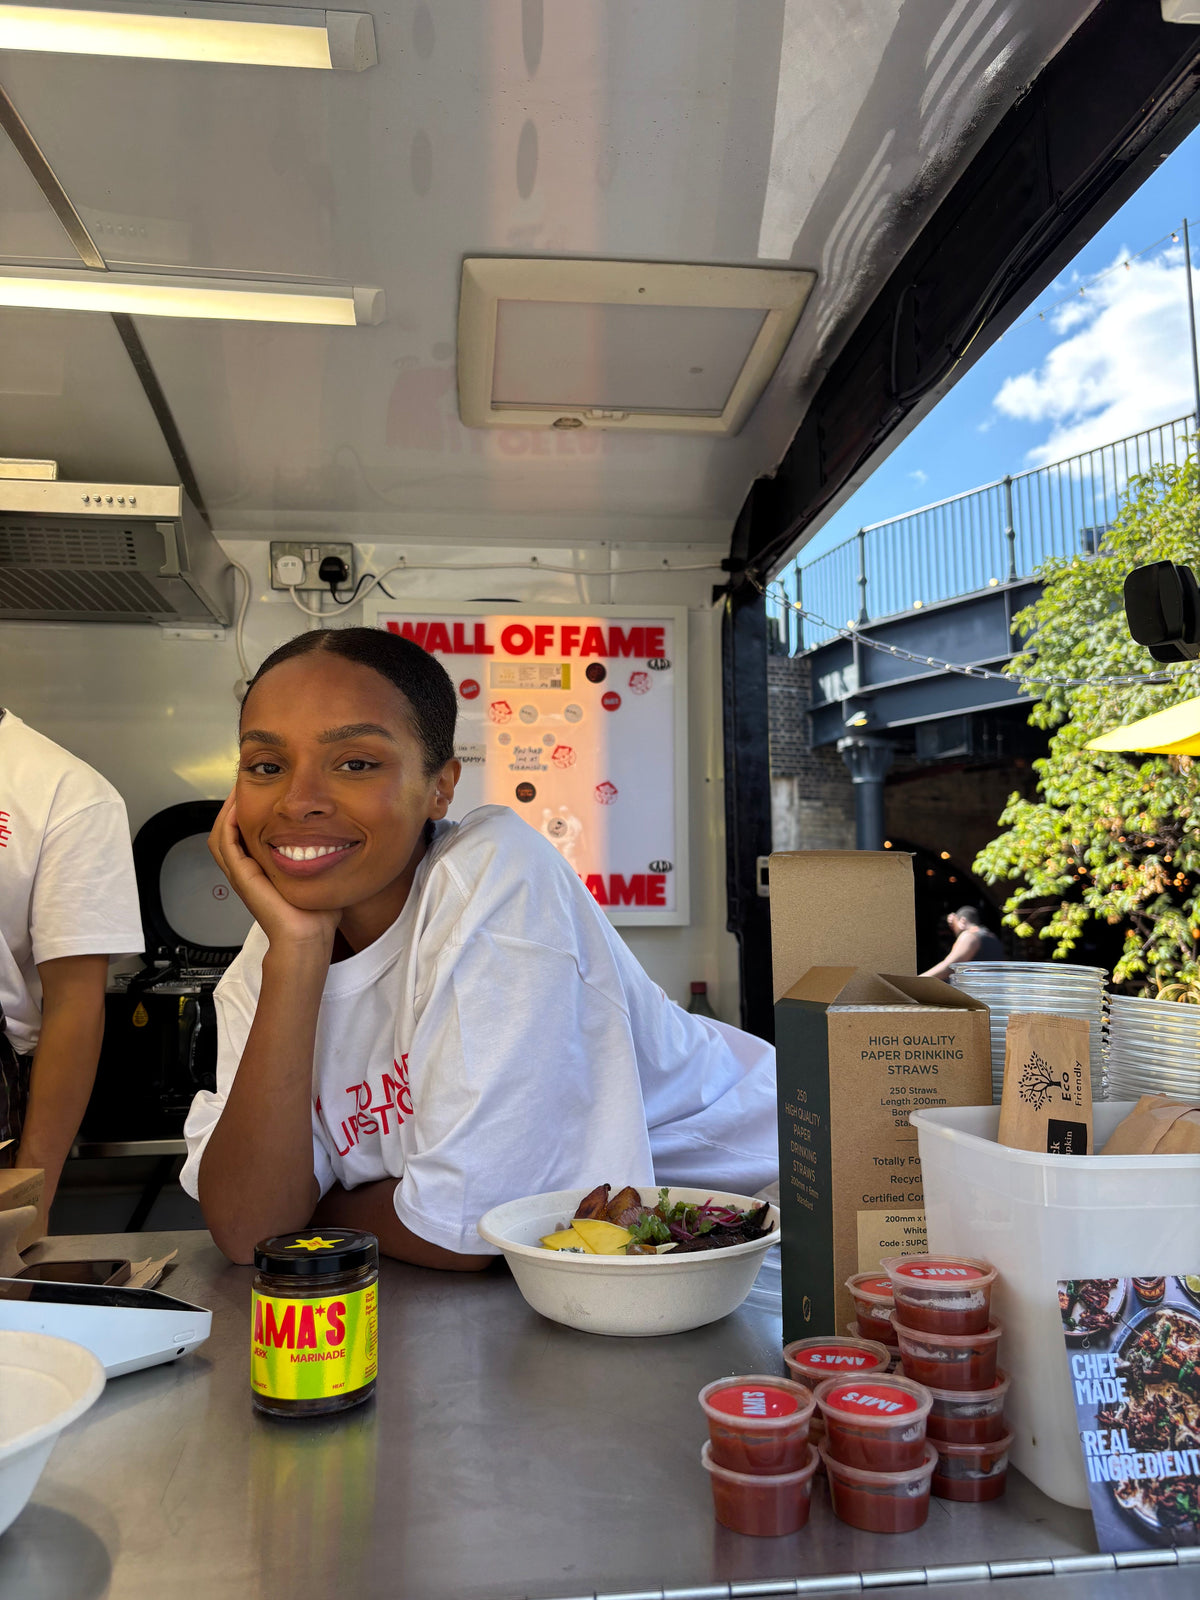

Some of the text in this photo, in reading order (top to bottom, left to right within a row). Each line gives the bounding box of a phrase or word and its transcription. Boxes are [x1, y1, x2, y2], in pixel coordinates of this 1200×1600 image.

[387, 621, 665, 658] WALL OF FAME
[581, 874, 666, 906] AME
[869, 1035, 956, 1046] HIGH QUALITY
[861, 1050, 963, 1060] PAPER DRINKING
[888, 1064, 939, 1075] STRAWS
[890, 1086, 938, 1095] 250 Straws
[1062, 1072, 1072, 1101] Eco
[1074, 1060, 1082, 1106] Friendly
[880, 1097, 947, 1106] Length 200mm
[784, 1102, 821, 1127] HIGH QUALITY
[793, 1123, 811, 1141] PAPER
[790, 1140, 817, 1164] DRINKING
[872, 1156, 906, 1167] Totally
[792, 1159, 816, 1182] STRAWS
[862, 1193, 905, 1203] Certified
[885, 1215, 916, 1223] 200mm
[879, 1239, 900, 1247] Code
[290, 1348, 346, 1363] MARINADE
[1071, 1353, 1120, 1379] CHEF
[1075, 1377, 1130, 1405] MADE
[1083, 1428, 1137, 1455] REAL
[1087, 1449, 1200, 1482] INGREDIENT
